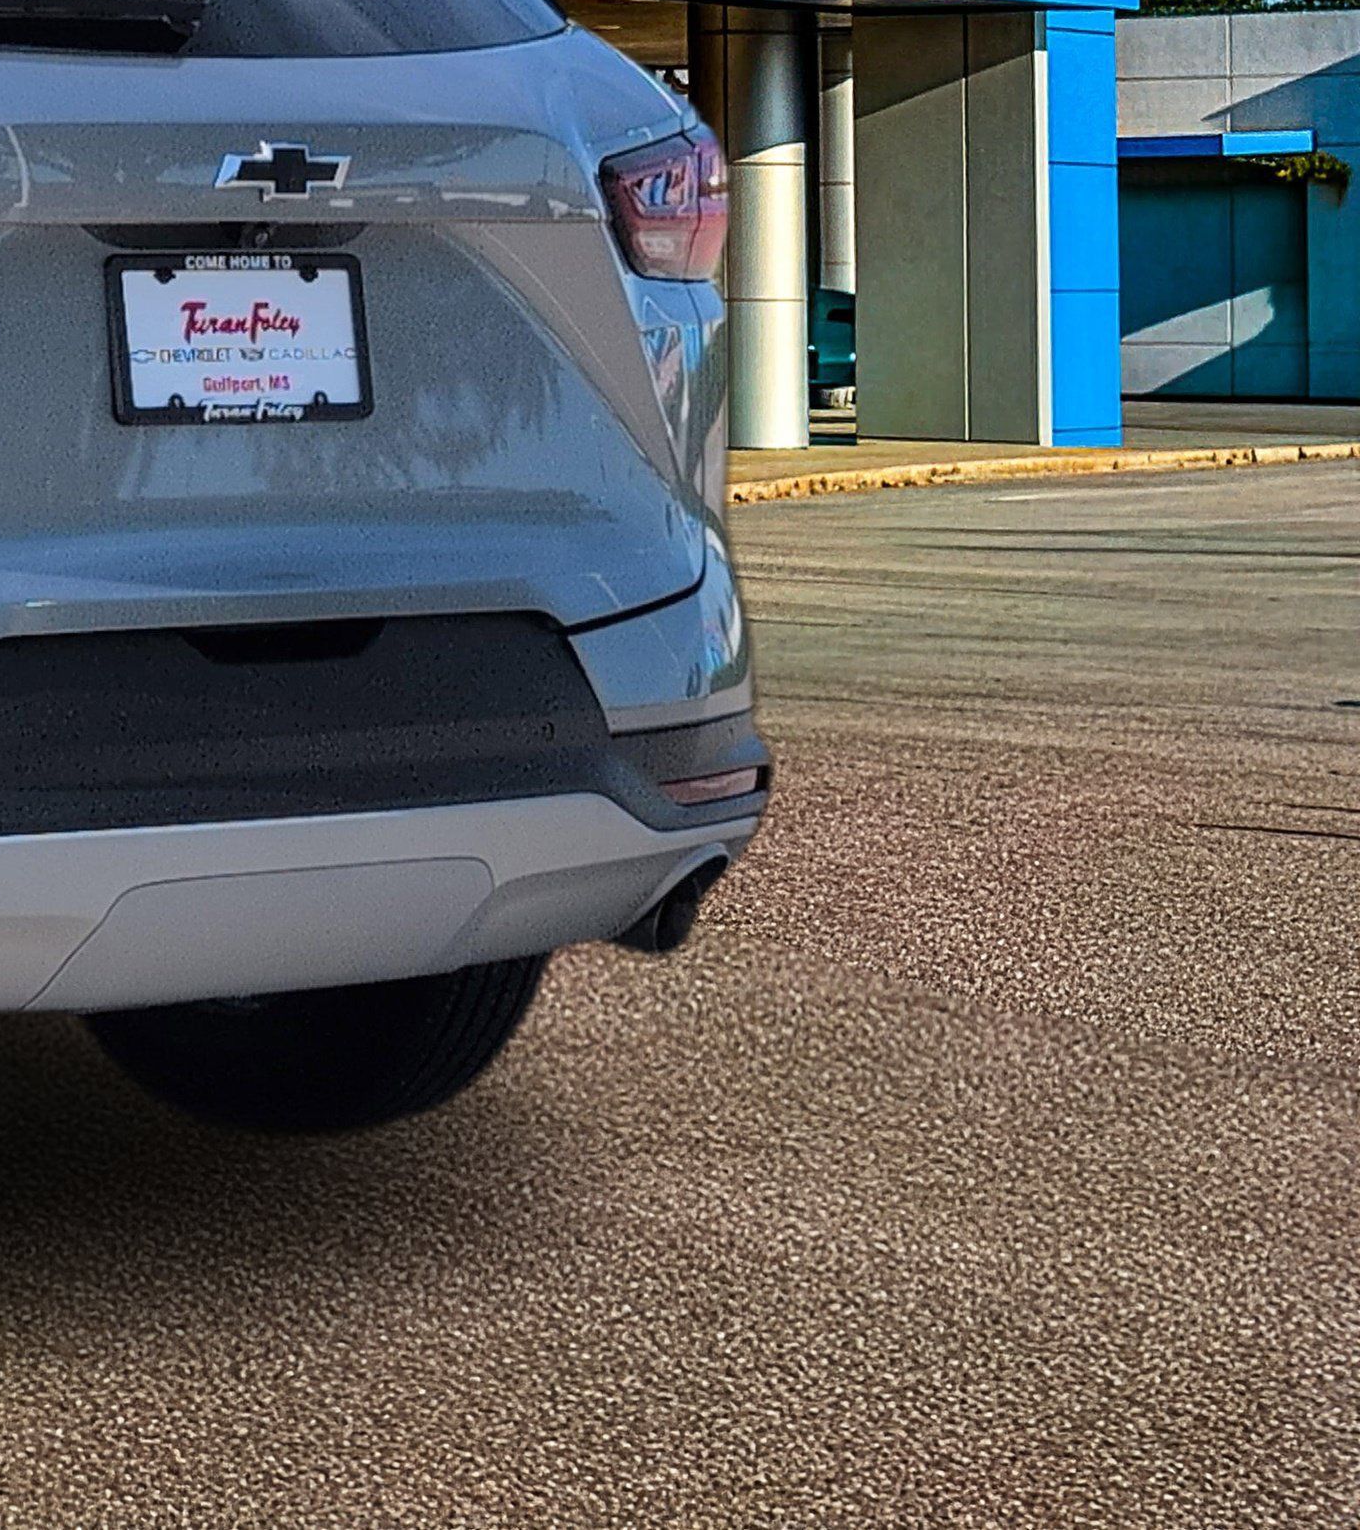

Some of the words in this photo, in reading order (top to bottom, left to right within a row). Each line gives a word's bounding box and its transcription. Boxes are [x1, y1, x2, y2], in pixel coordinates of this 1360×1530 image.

[185, 255, 226, 269] COME
[273, 255, 292, 269] TO
[269, 347, 357, 360] CADILLAC
